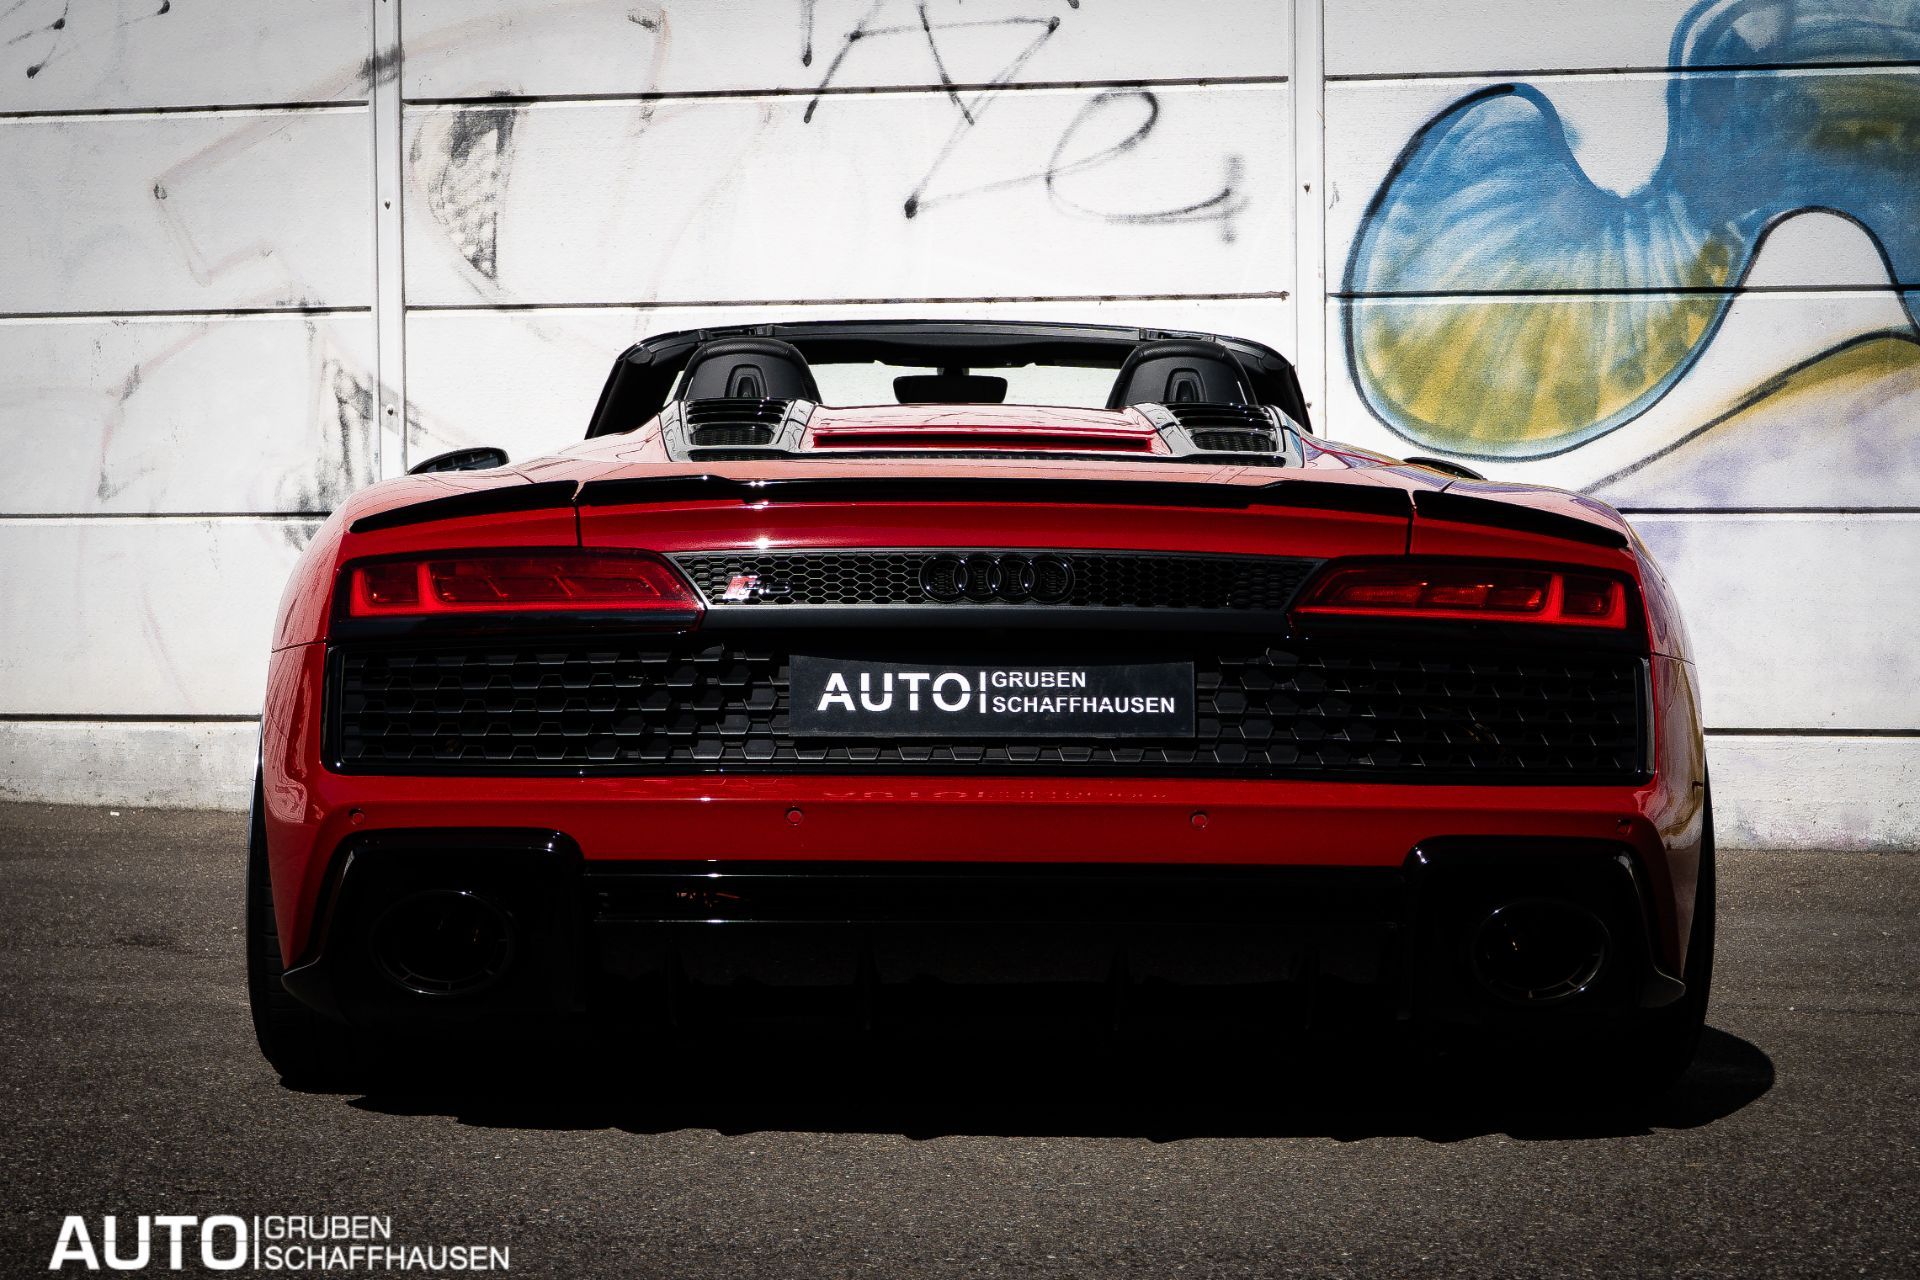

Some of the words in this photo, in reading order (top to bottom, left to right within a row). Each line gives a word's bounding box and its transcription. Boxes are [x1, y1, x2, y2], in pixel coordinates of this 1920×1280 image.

[991, 671, 1086, 688] GRUBEN
[817, 672, 972, 712] AUTO
[991, 696, 1175, 713] SCHAFFHAUSEN
